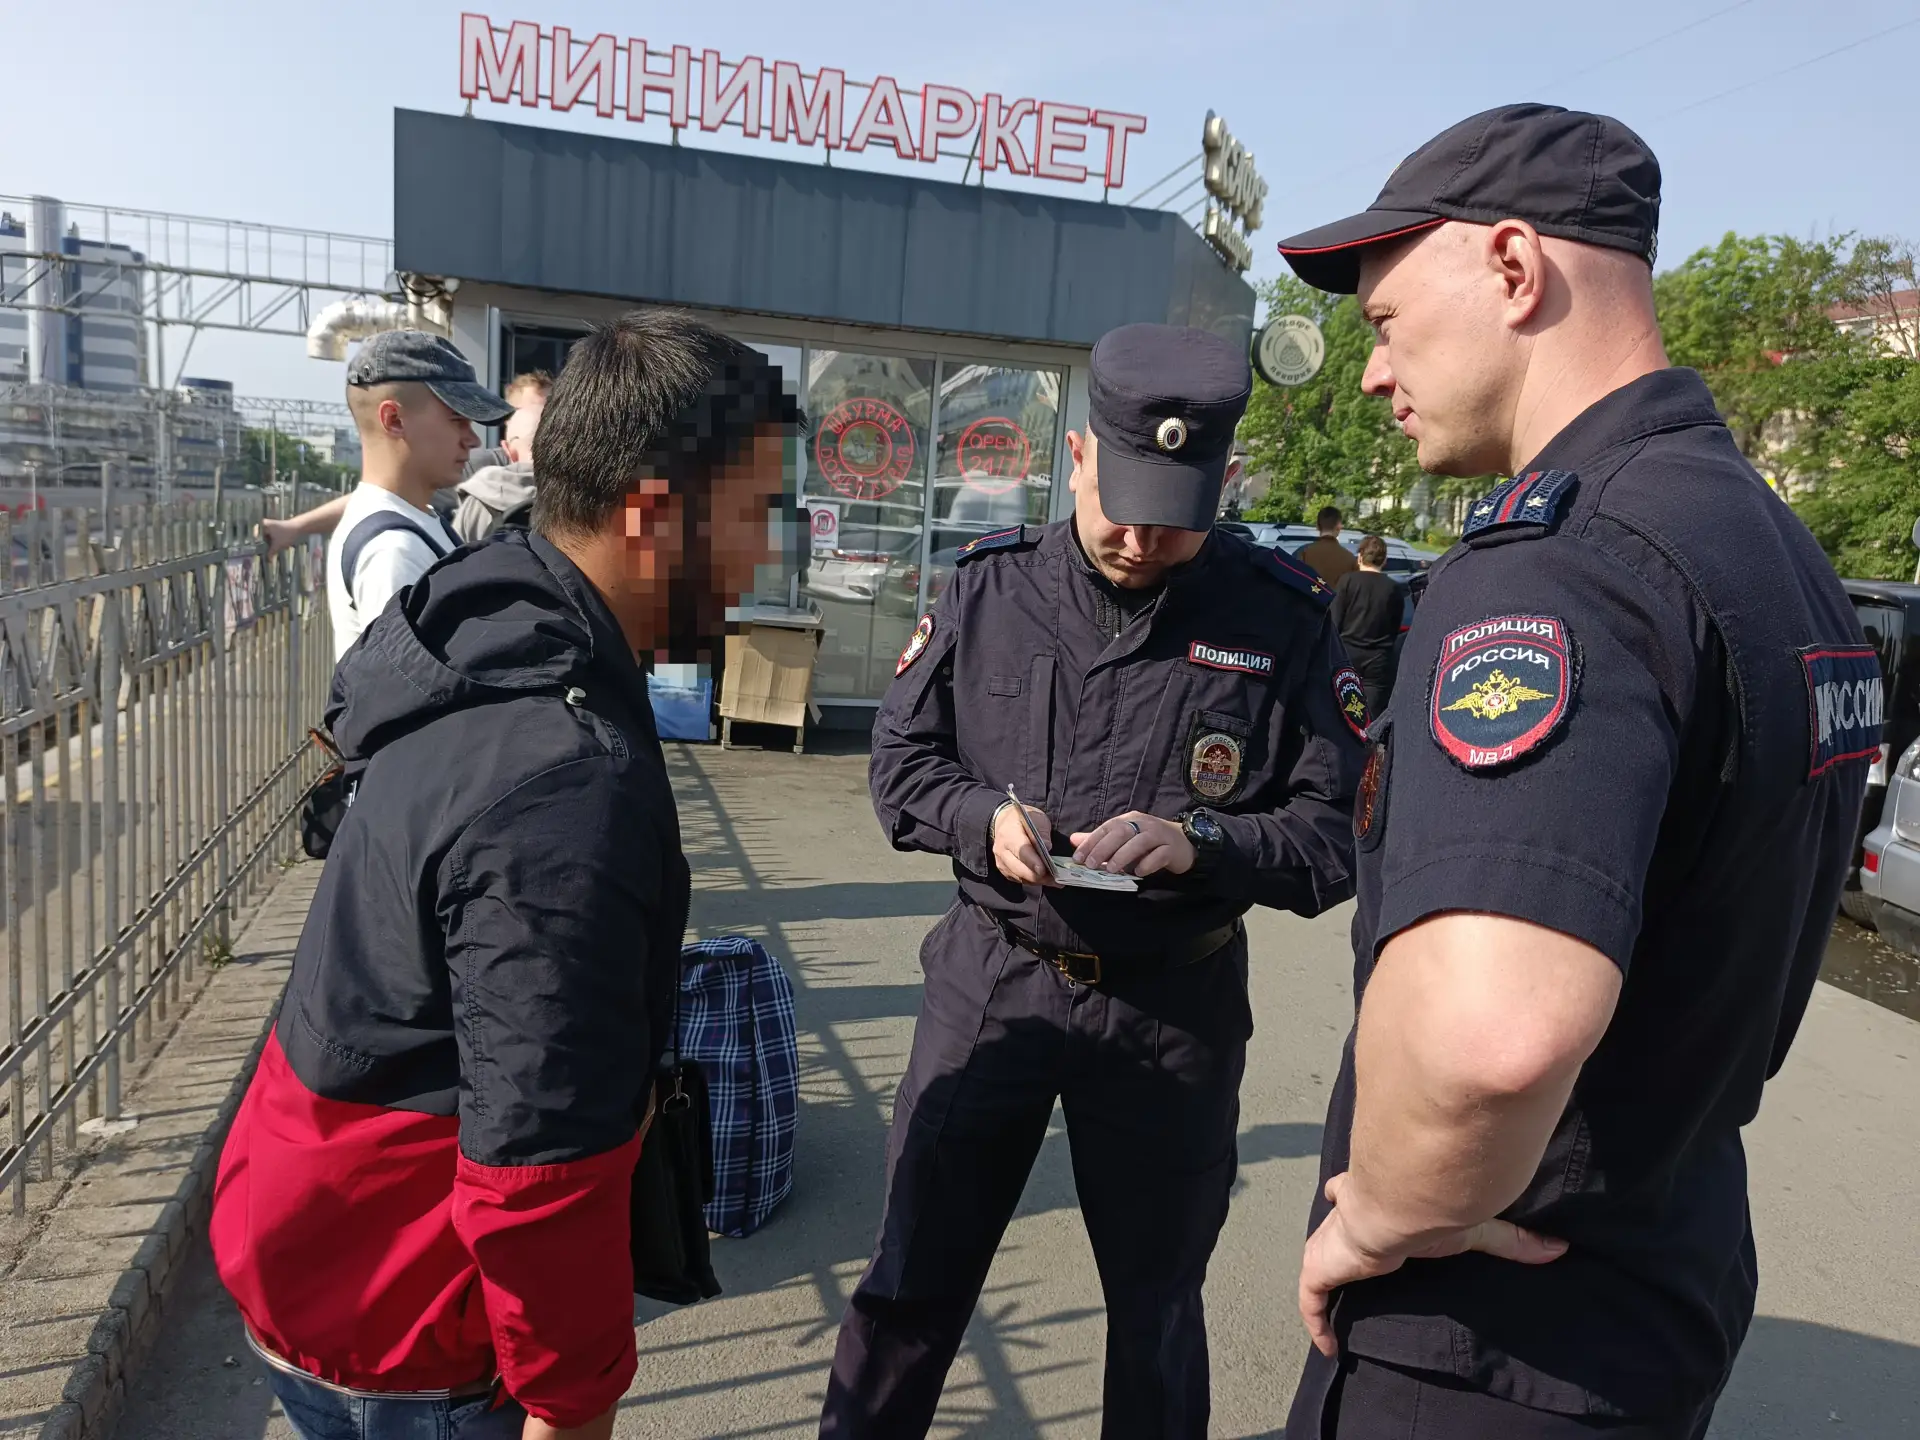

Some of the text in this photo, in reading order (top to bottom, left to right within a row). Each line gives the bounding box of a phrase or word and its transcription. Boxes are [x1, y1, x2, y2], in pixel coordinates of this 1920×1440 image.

[460, 12, 1147, 189] МИНИМАРКЕТ
[827, 402, 903, 434] ШАУРМА
[969, 433, 1019, 451] OPEN
[970, 455, 1018, 477] 24/7
[1451, 620, 1554, 652] ПОЛИЦИЯ
[1195, 644, 1272, 671] ПОЛИЦИЯ
[1451, 646, 1550, 683] РОССИЯ
[1469, 744, 1514, 765] МВД
